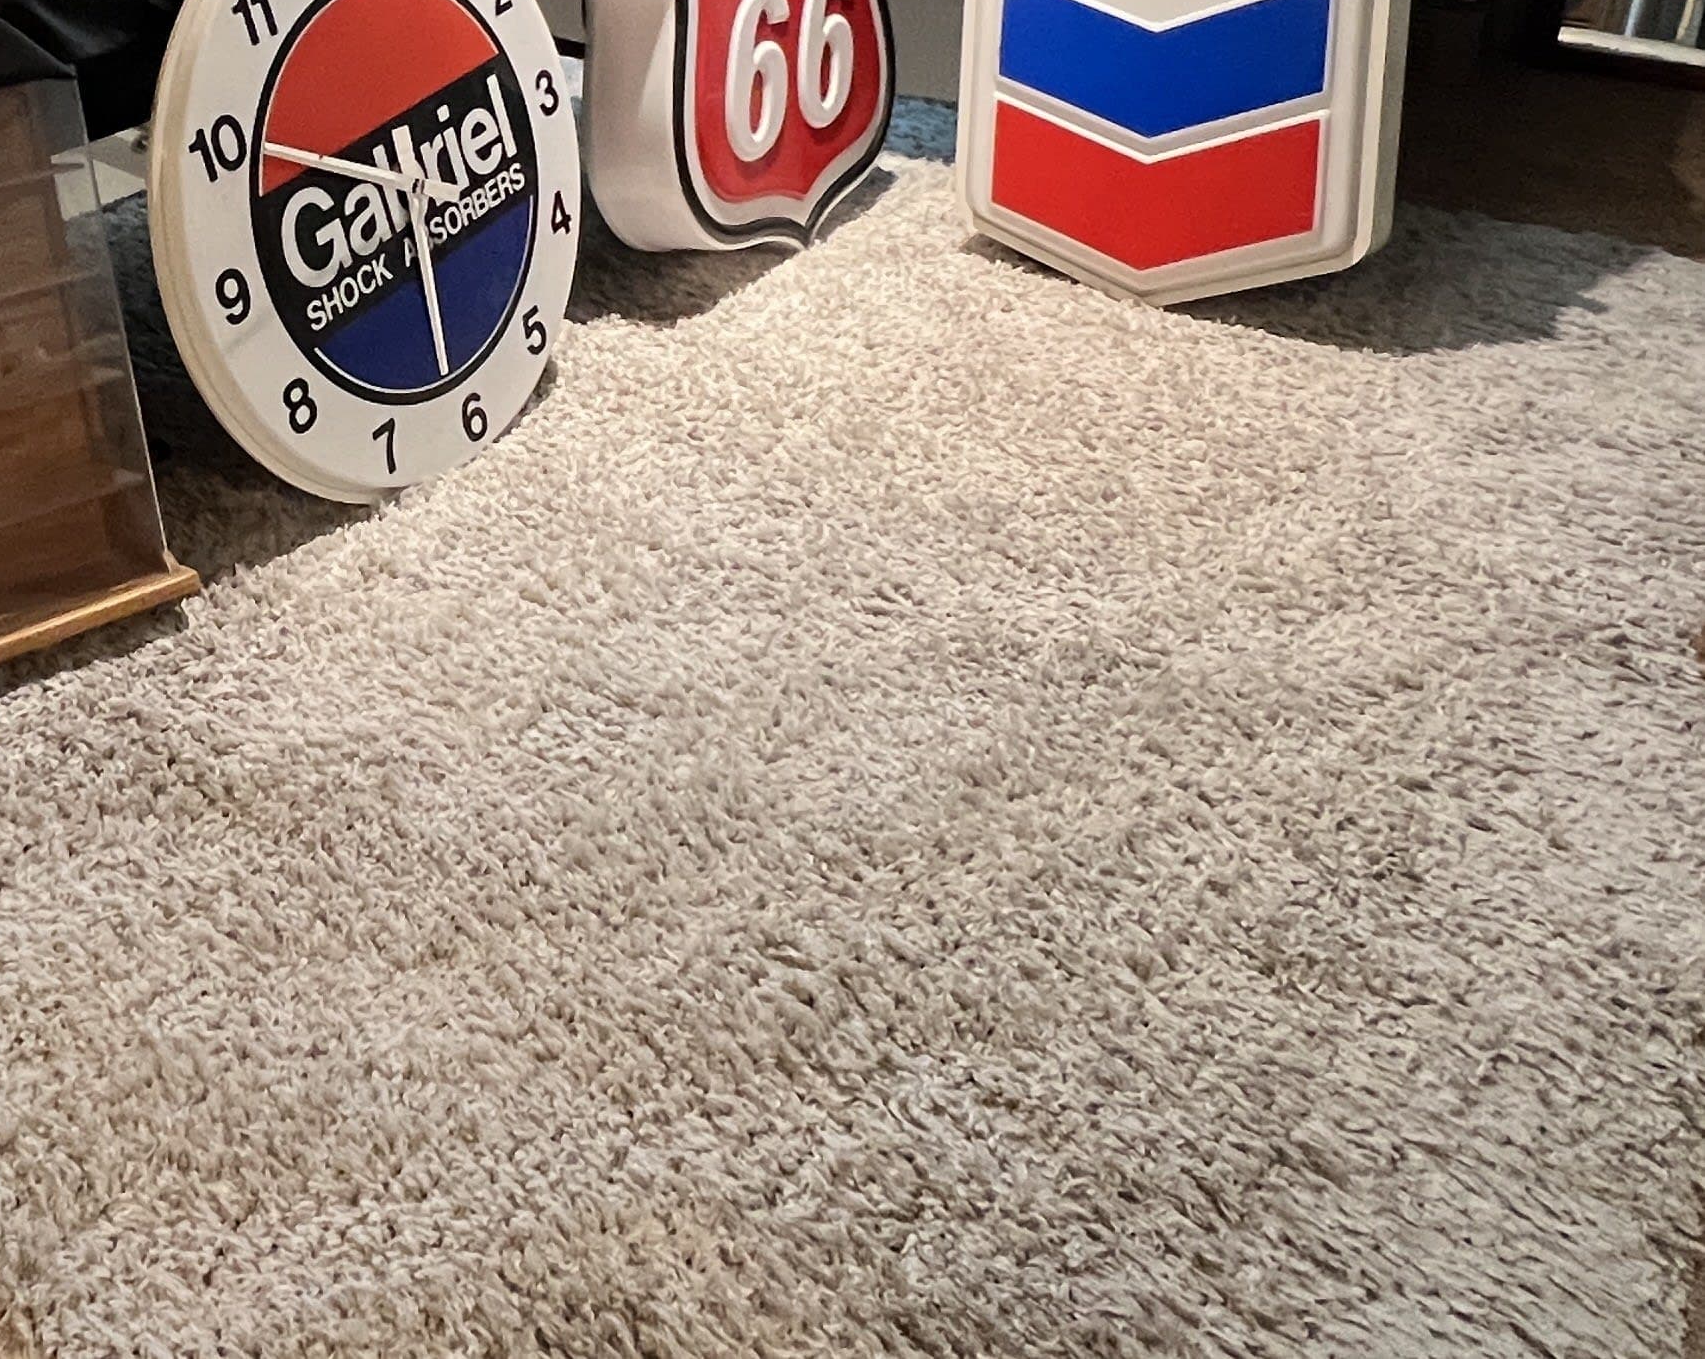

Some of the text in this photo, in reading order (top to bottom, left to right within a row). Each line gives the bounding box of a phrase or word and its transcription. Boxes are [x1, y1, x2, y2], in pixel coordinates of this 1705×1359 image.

[535, 70, 559, 116] 3
[189, 115, 247, 182] 10
[551, 191, 572, 234] 4
[306, 162, 526, 332] SHOCK ASORBERS
[216, 269, 250, 325] 9
[523, 305, 547, 355] 5
[283, 378, 317, 434] 8
[461, 393, 488, 442] 6
[373, 418, 396, 474] 7
